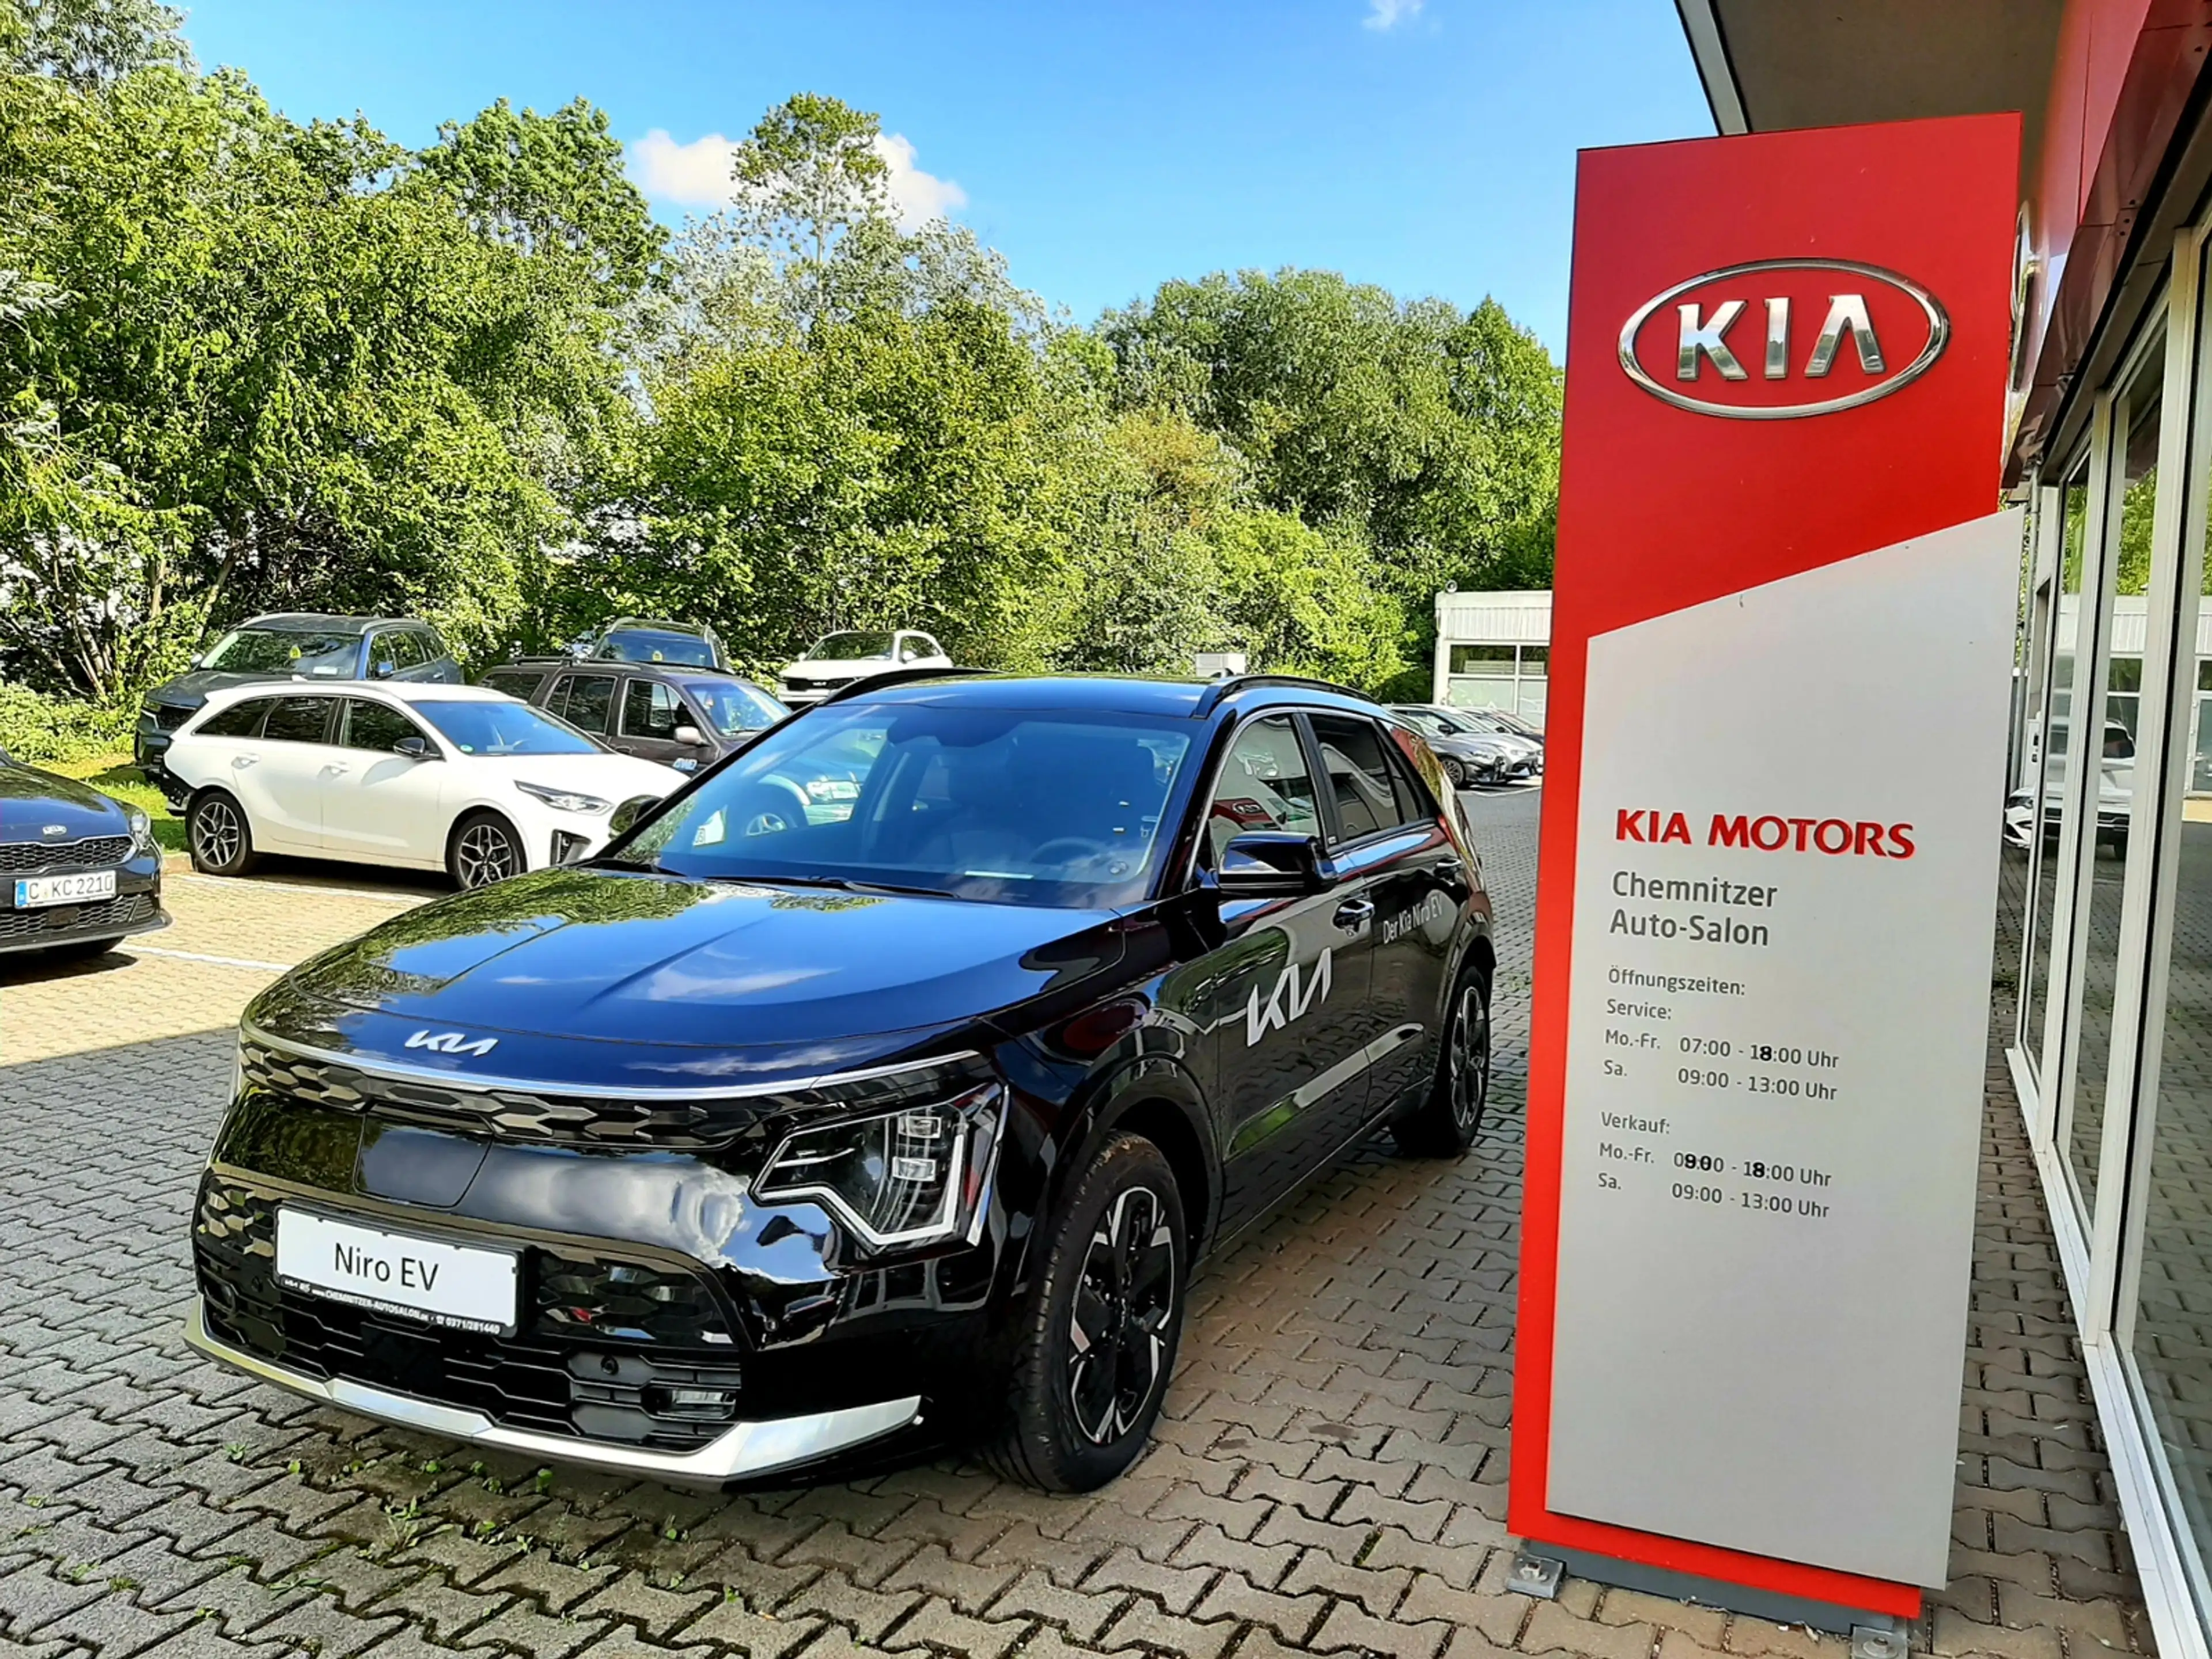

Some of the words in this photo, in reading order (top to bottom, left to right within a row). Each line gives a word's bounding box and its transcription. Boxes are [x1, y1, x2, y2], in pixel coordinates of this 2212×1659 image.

[1676, 294, 1887, 381] KIA
[1615, 808, 1692, 846] KIA
[1707, 813, 1916, 861] MOTORS
[29, 882, 39, 899] C
[52, 880, 73, 897] KC
[76, 875, 113, 894] 2210
[1612, 870, 1779, 907] Chemnitzer
[1383, 921, 1399, 944] Der
[1399, 910, 1412, 936] Kia
[1412, 903, 1430, 928] Niro
[1609, 908, 1772, 946] Auto-Salon
[1247, 946, 1332, 1048] KIA
[1608, 964, 1745, 996] Öffnungszeiten:
[1606, 998, 1672, 1020] Service:
[404, 1029, 499, 1056] KIA
[1605, 1028, 1661, 1050] Mo.-Fr.
[1679, 1036, 1731, 1058] 07:00
[1749, 1044, 1802, 1065] 18:00
[1808, 1049, 1839, 1069] Uhr
[1603, 1059, 1628, 1077] Sa.
[1677, 1067, 1729, 1088] 09:00
[1748, 1075, 1800, 1096] 13:00
[1805, 1081, 1838, 1101] Uhr
[1601, 1111, 1671, 1135] Verkauf:
[1599, 1142, 1655, 1164] Mo.-Fr.
[1743, 1161, 1794, 1183] 18:00
[1800, 1167, 1832, 1187] Uhr
[1597, 1172, 1622, 1190] Sa.
[1671, 1182, 1723, 1204] 09:00
[1741, 1192, 1793, 1214] 13:00
[1798, 1199, 1830, 1218] Uhr
[335, 1243, 391, 1282] Niro
[400, 1257, 439, 1291] EV
